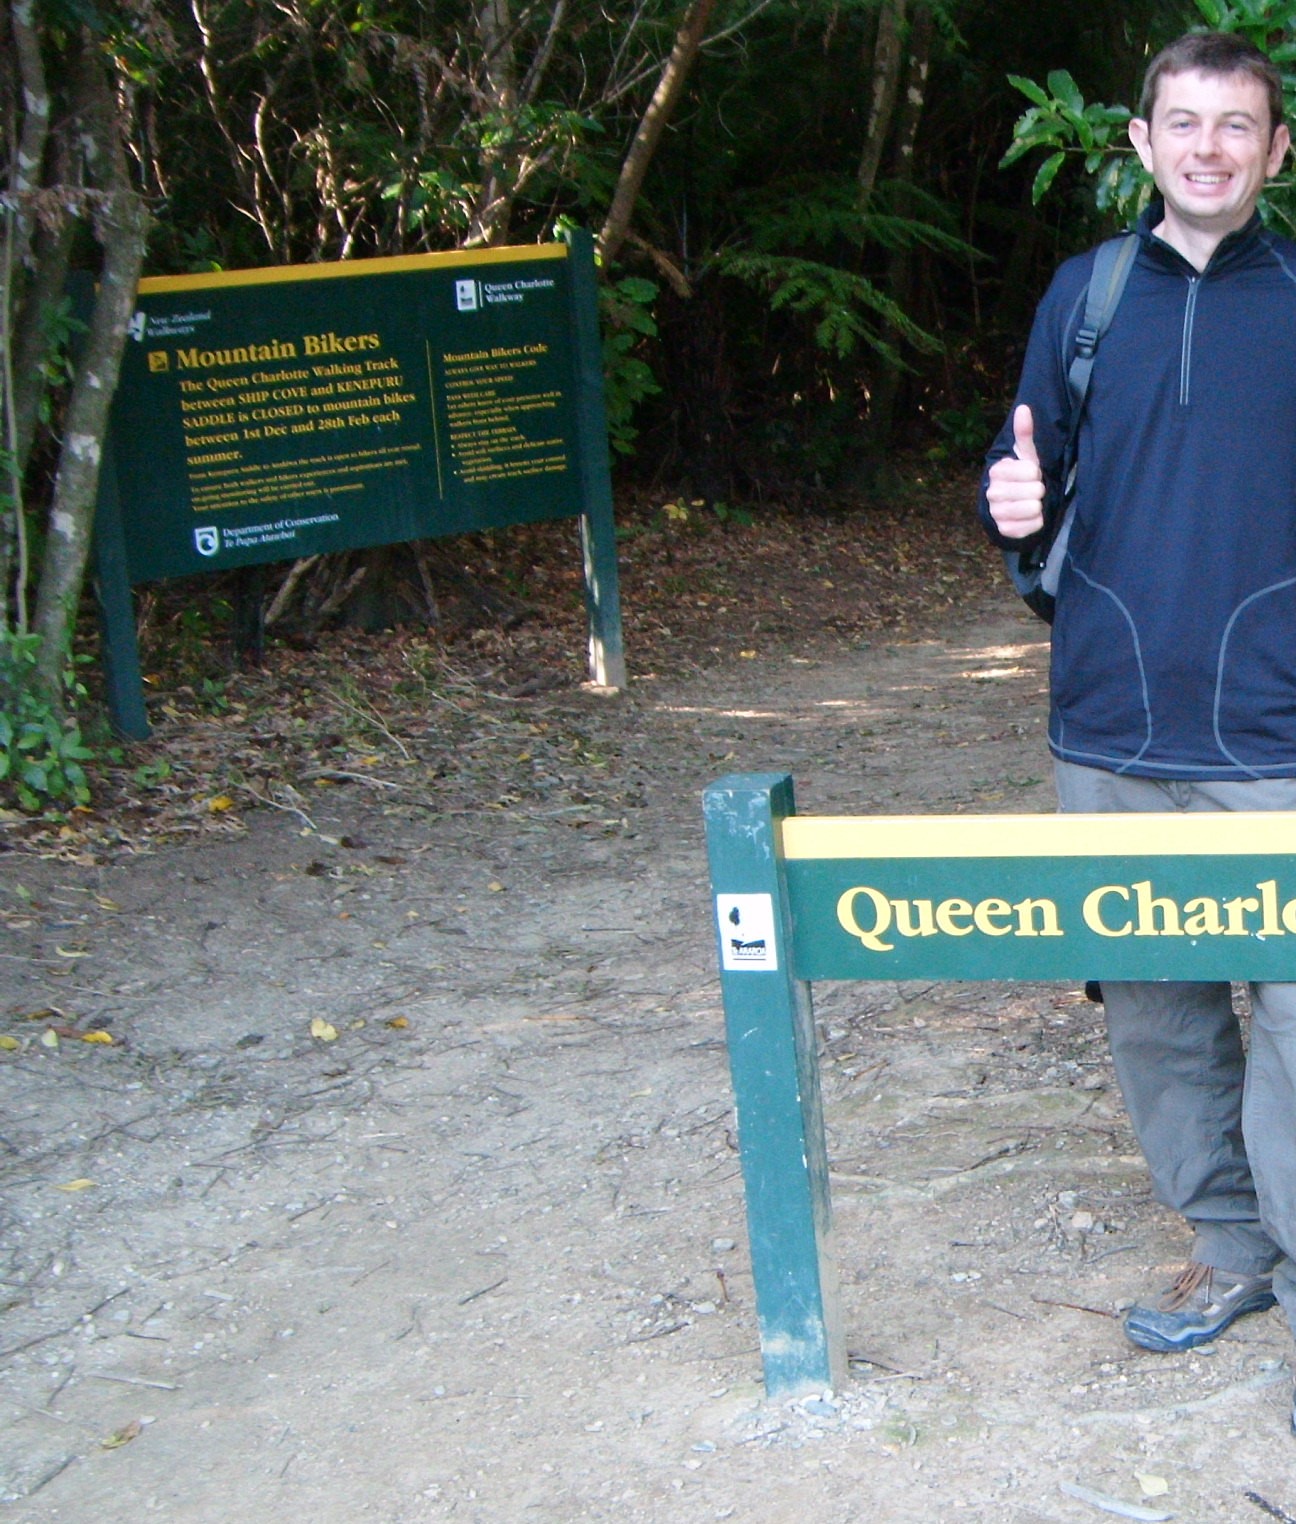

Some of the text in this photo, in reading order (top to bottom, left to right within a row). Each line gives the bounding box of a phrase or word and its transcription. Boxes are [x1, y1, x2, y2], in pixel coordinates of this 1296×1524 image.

[484, 279, 554, 294] Queen Charlotte
[486, 293, 524, 304] Walkway
[176, 332, 381, 370] Mountain Bikers
[443, 343, 548, 363] Mountain Bikers Code
[179, 358, 399, 393] The Queen Charlotte Walking Track
[180, 376, 404, 412] between SHIP COVE and KENEPURU
[182, 390, 416, 430] SADDLE is CLOSED to mountain bikes
[185, 408, 401, 448] between 1st Dec and 28th Feb each
[187, 450, 244, 466] summer.
[223, 513, 340, 538] Department of Conservation
[224, 530, 296, 549] Te Papa Atawhai
[836, 886, 1062, 951] Queen
